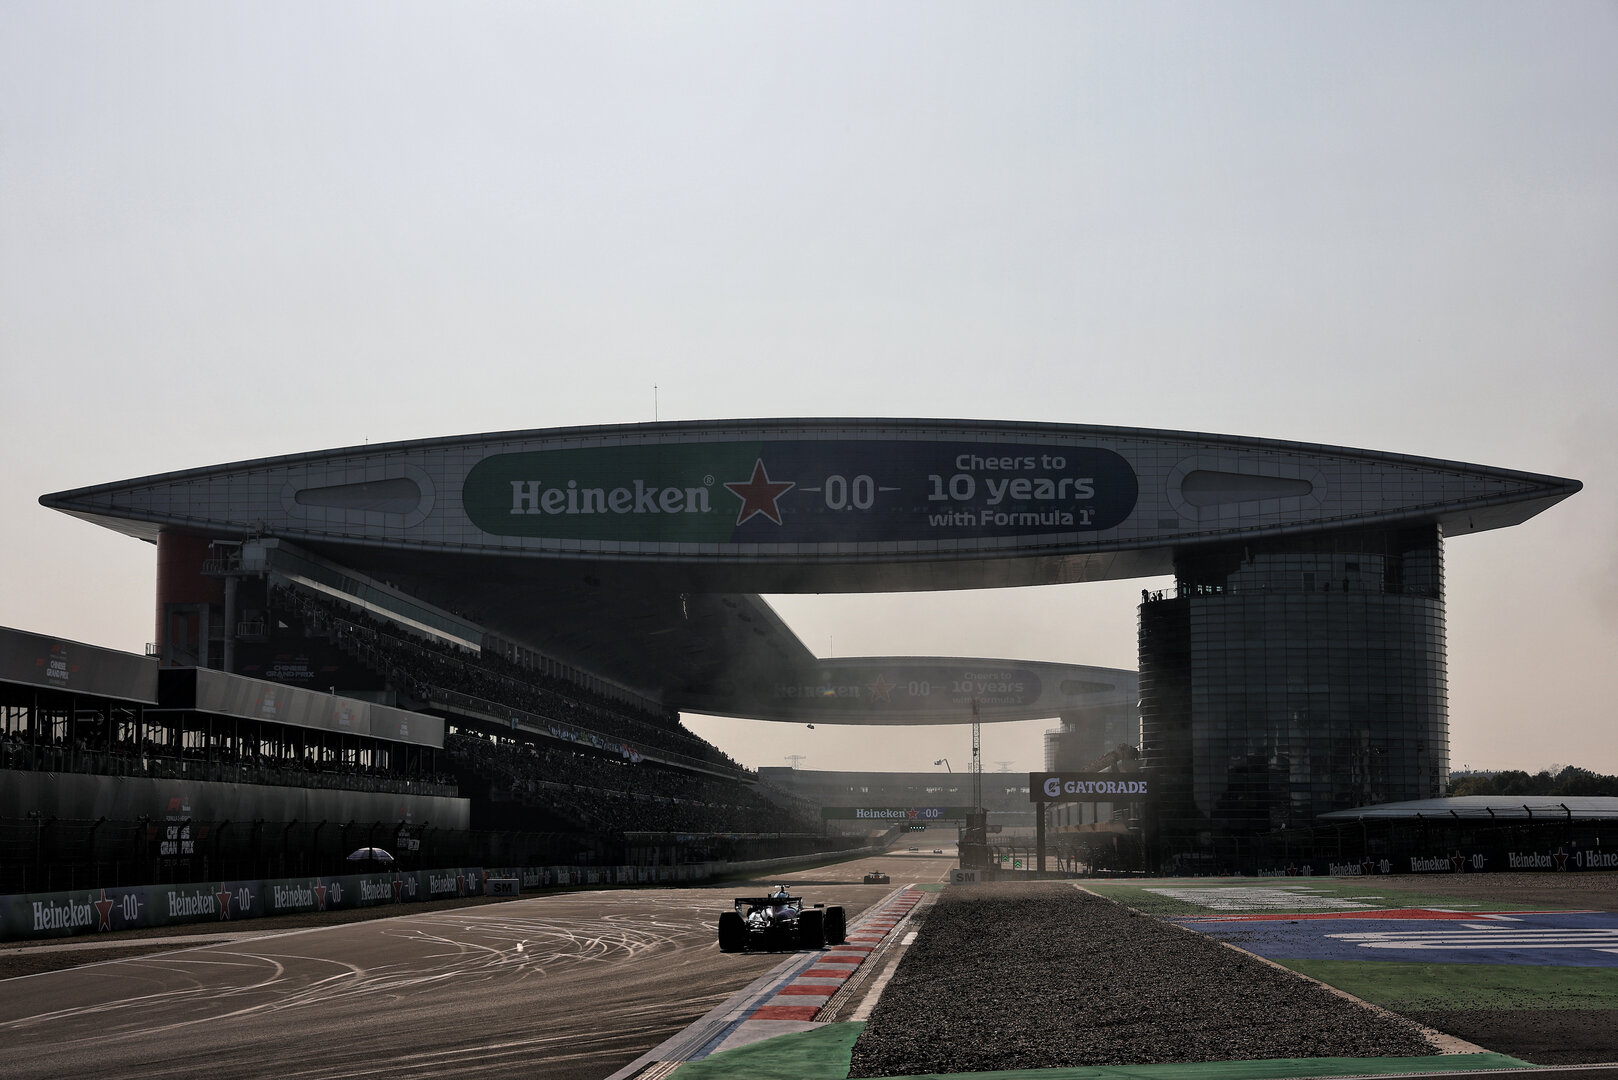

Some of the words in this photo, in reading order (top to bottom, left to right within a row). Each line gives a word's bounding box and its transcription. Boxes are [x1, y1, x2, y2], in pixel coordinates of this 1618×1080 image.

[955, 454, 1036, 470] Cheers
[1041, 454, 1067, 470] to
[824, 474, 875, 510] 0.0
[927, 474, 976, 501] 10
[984, 477, 1096, 505] years
[928, 509, 976, 527] with
[980, 509, 1074, 526] Formula
[952, 681, 974, 693] 10
[976, 681, 1025, 694] years
[1064, 780, 1148, 794] GATORADE
[856, 808, 906, 818] Heineken
[1410, 854, 1450, 872] Heineken
[1508, 850, 1551, 869] Heineken
[956, 872, 976, 883] SM
[1329, 861, 1362, 877] Heineken
[274, 884, 313, 909] Heineken
[493, 883, 513, 893] SM
[168, 888, 215, 917] Heineken
[33, 897, 93, 931] Heineken
[123, 894, 138, 921] 0.0
